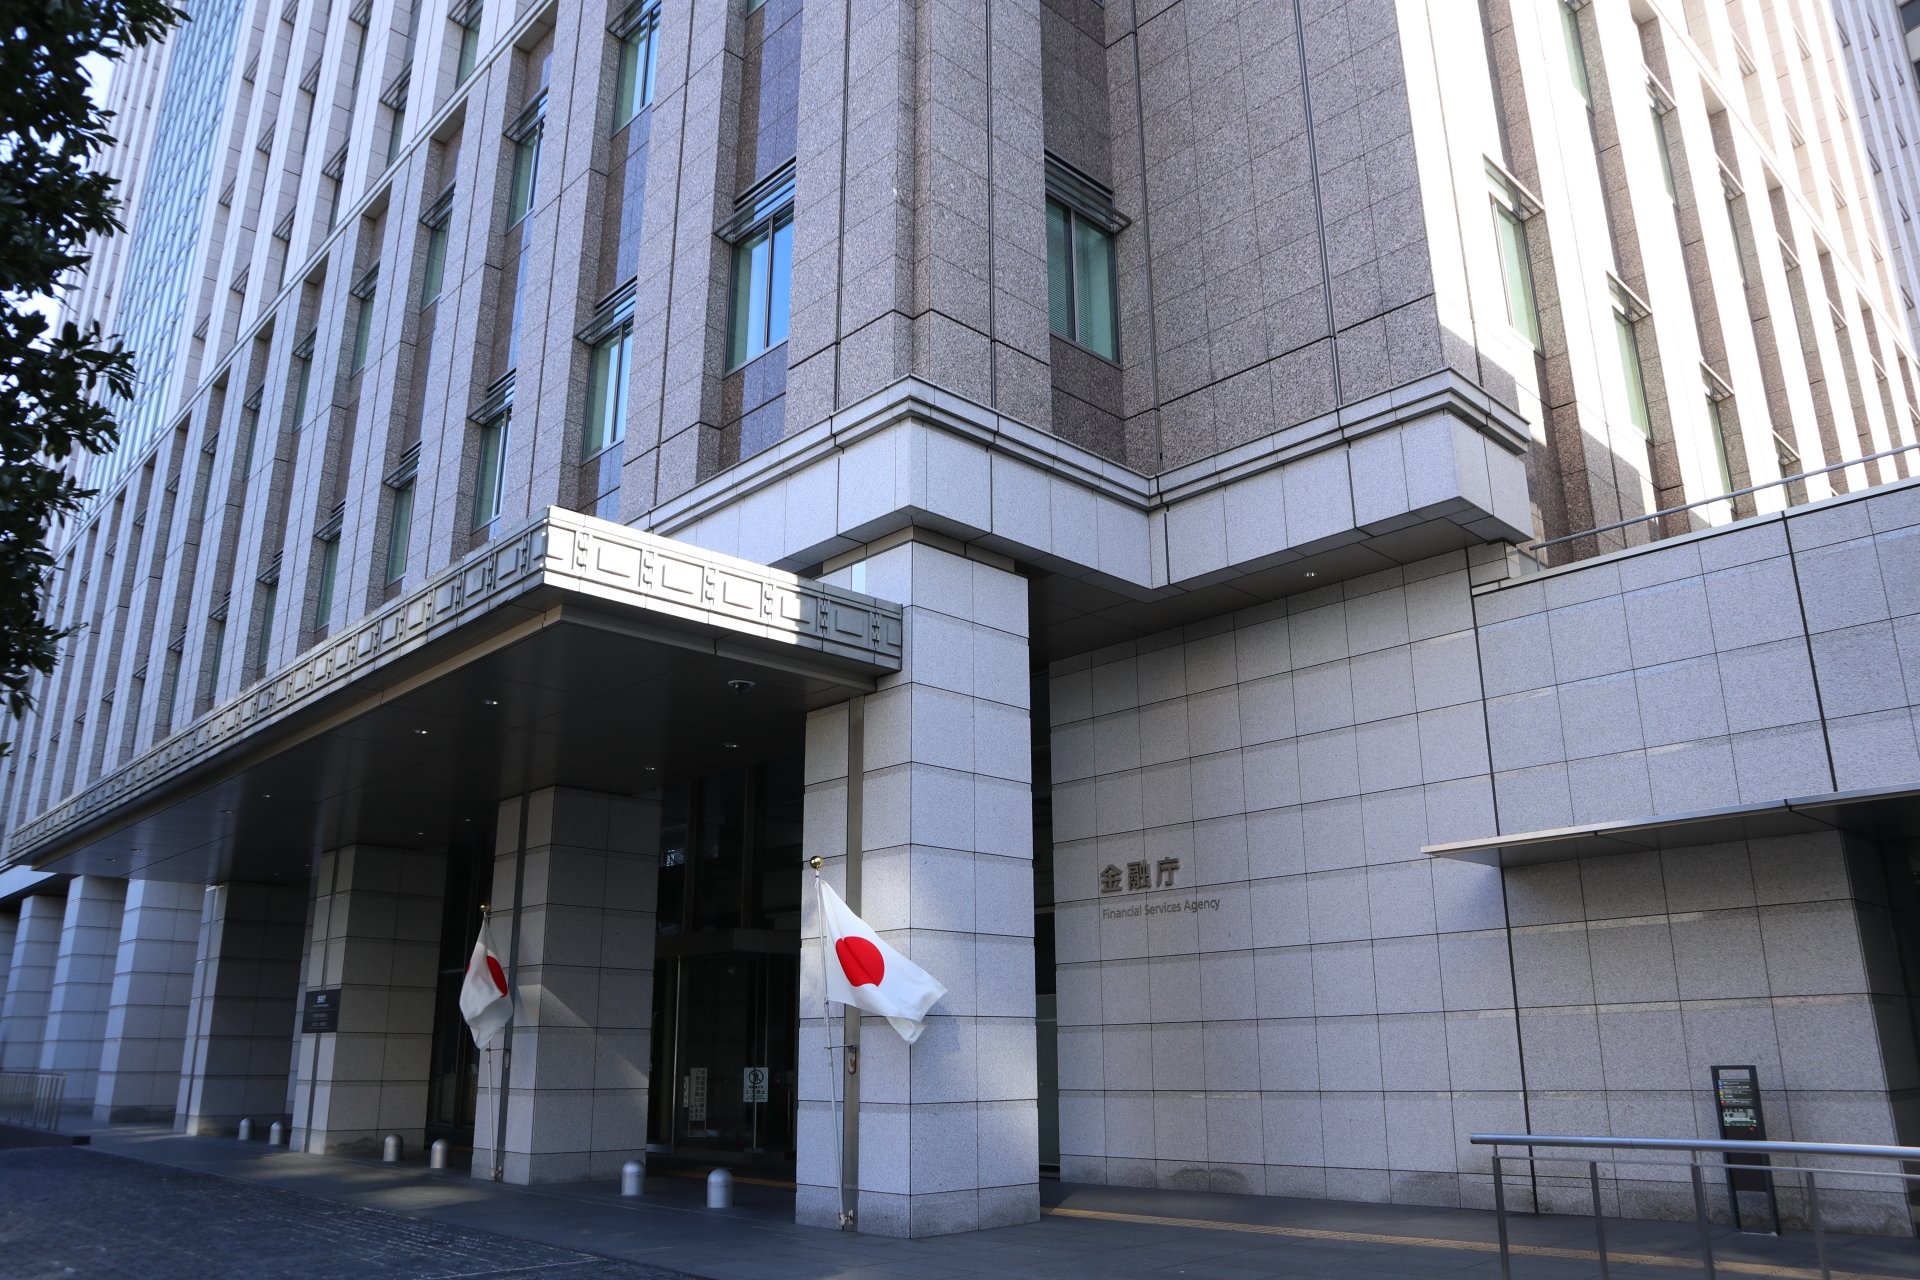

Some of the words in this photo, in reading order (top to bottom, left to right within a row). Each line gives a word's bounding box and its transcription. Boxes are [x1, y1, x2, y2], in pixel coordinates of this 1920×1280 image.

[1100, 857, 1180, 893] 金融庁
[1103, 905, 1142, 919] Financial
[1144, 902, 1181, 916] Services
[1184, 899, 1220, 913] Agency
